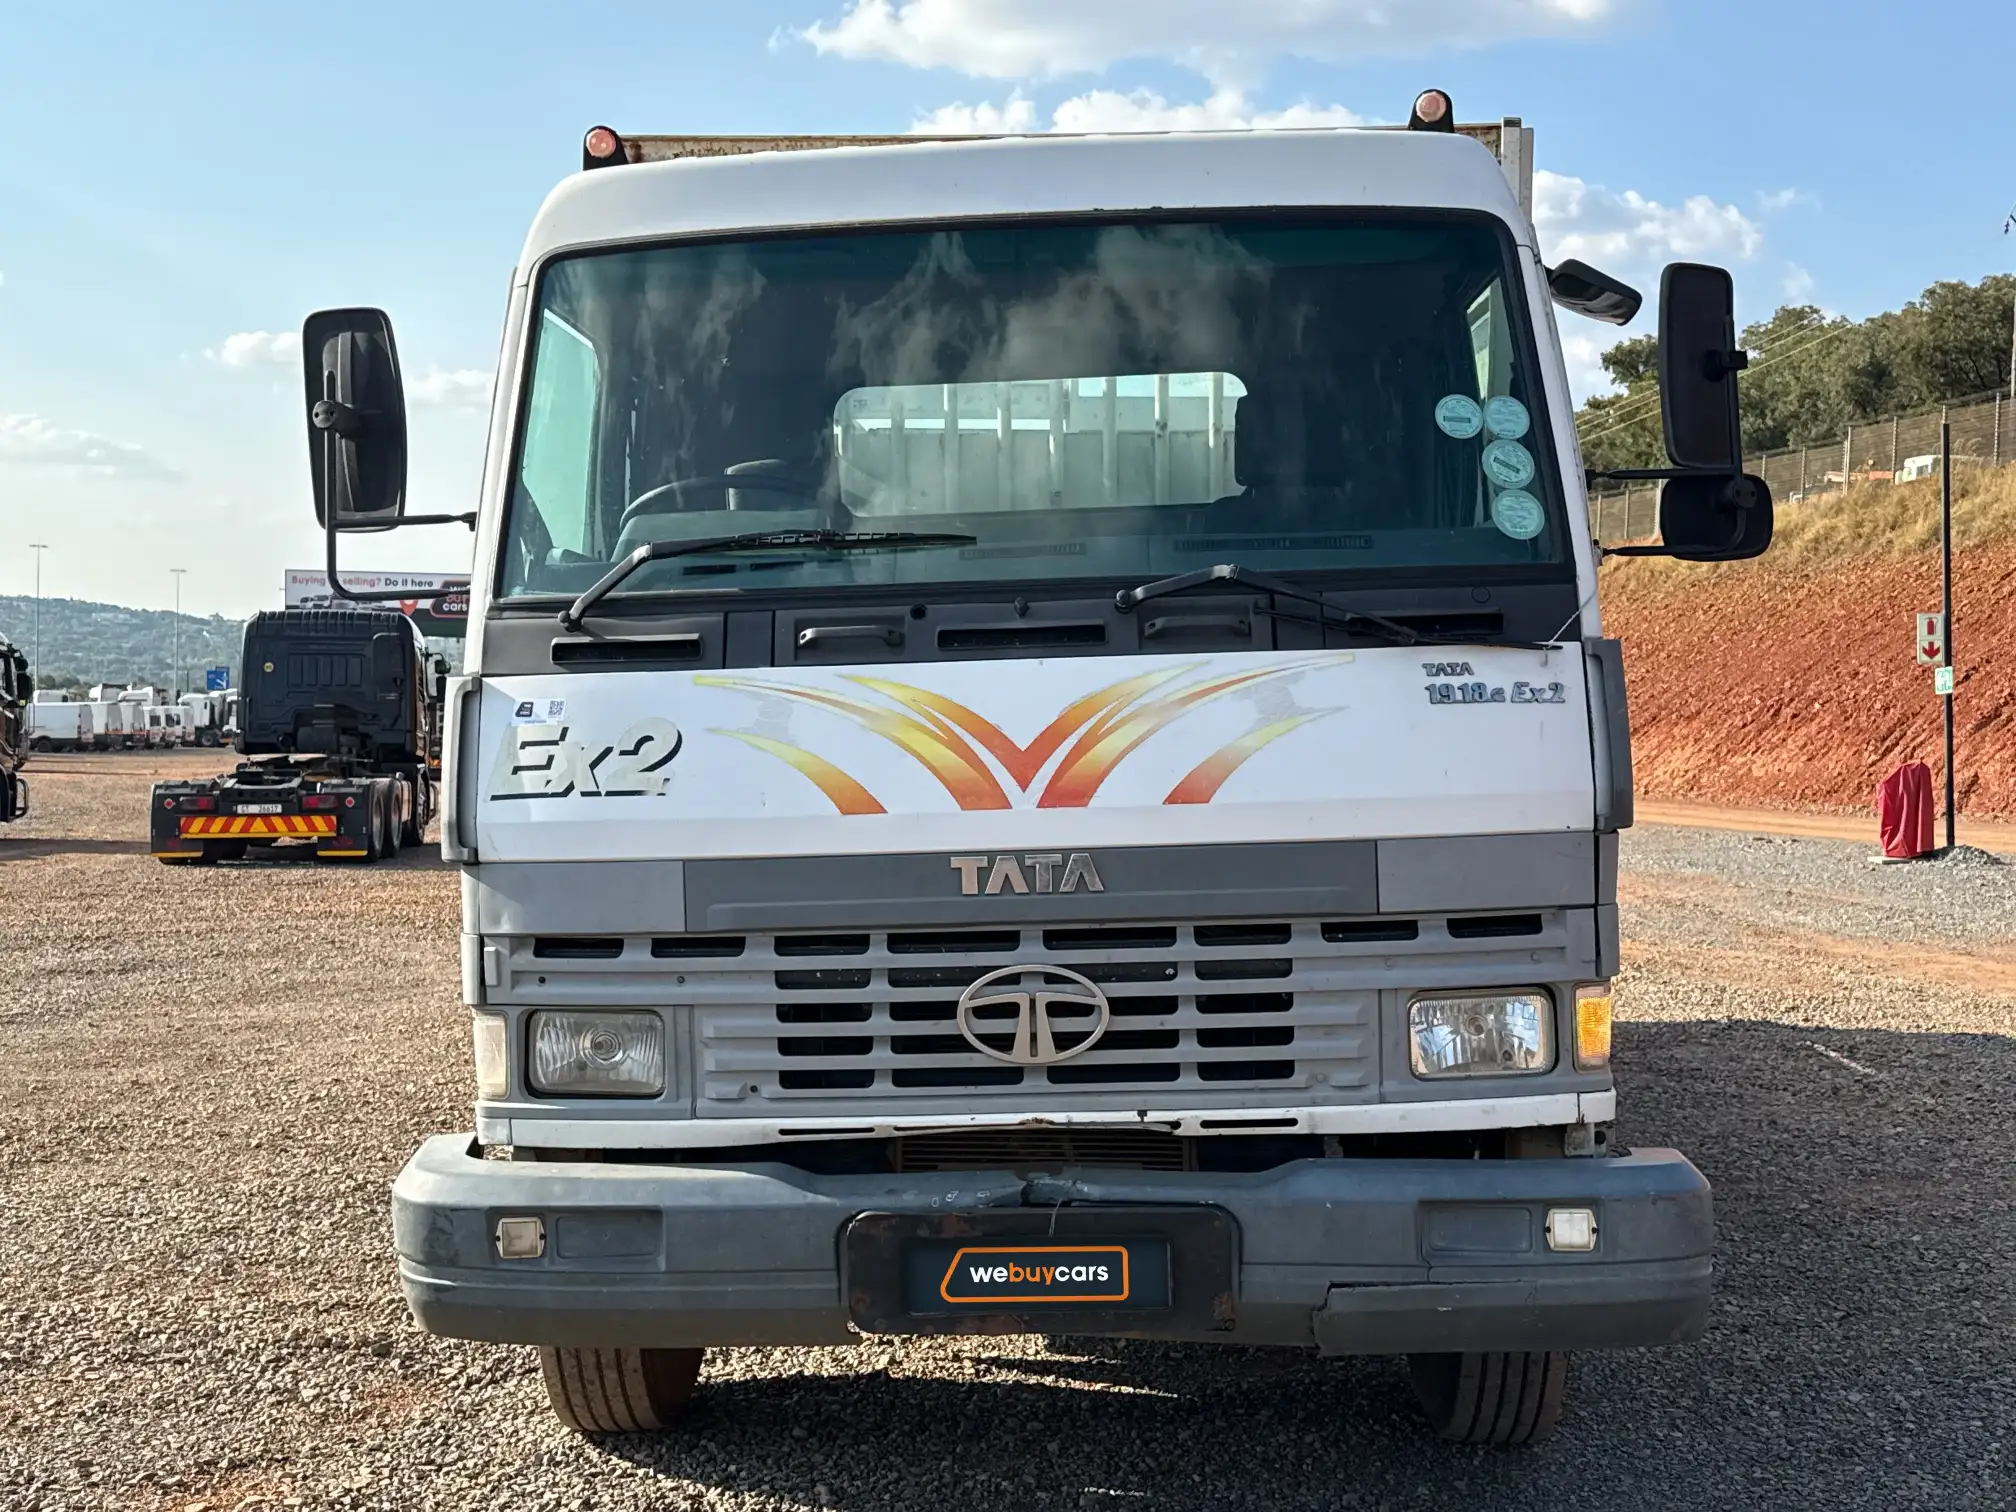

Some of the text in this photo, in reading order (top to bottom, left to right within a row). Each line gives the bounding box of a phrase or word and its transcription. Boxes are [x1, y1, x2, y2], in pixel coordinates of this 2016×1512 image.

[292, 575, 434, 588] Buying selling? Do it here
[442, 602, 468, 612] cars
[1421, 662, 1475, 677] TATA
[1510, 681, 1566, 704] Ex2
[487, 717, 683, 803] Ex2
[950, 853, 1105, 895] TATA
[969, 1262, 1109, 1286] webuycars
